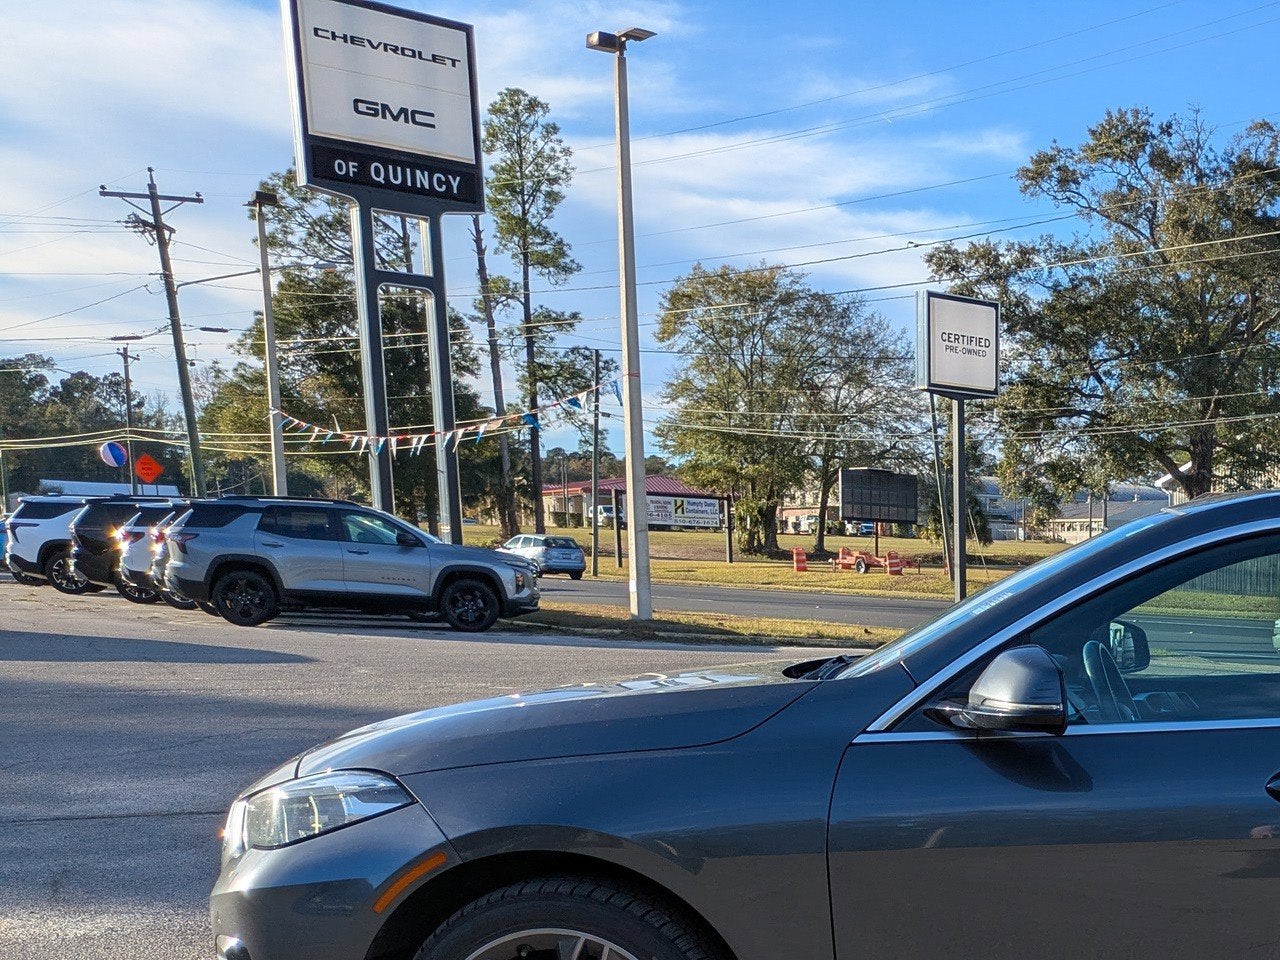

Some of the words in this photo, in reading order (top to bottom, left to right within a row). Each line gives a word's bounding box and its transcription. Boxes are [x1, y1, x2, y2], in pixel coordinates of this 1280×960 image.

[313, 26, 461, 68] CHEVROLET
[353, 98, 436, 129] GMC
[334, 158, 358, 178] OF
[370, 162, 461, 194] QUINCY
[940, 331, 991, 349] CERTIFIED
[944, 344, 987, 358] PRE-OWNED
